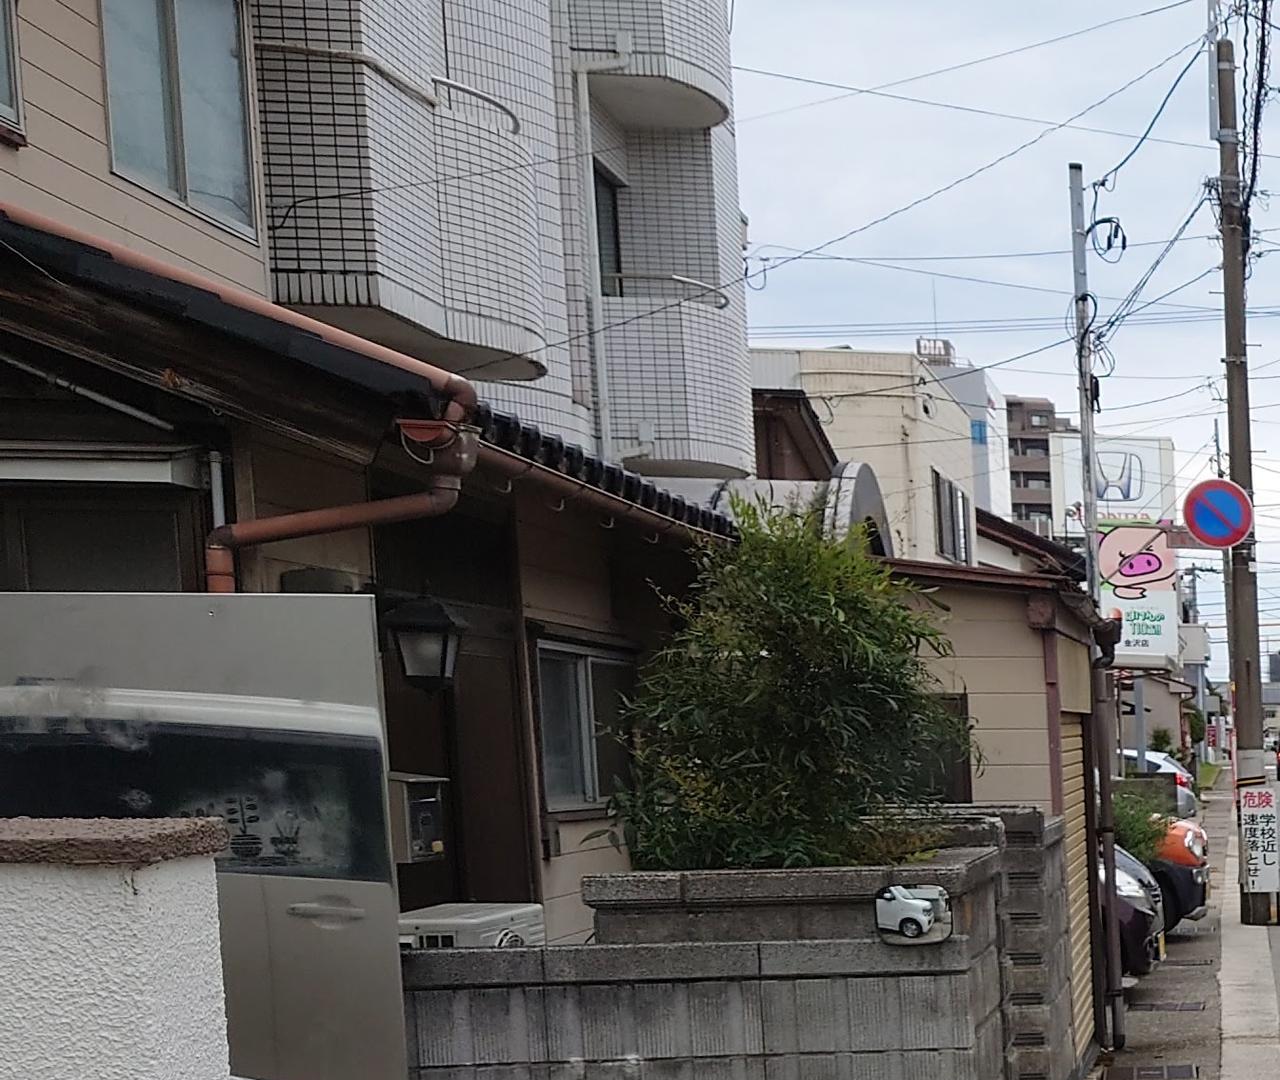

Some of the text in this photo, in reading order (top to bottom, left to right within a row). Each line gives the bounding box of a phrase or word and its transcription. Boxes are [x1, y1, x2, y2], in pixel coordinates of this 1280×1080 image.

[1243, 791, 1273, 808] 危険
[1259, 813, 1277, 866] 学校近し
